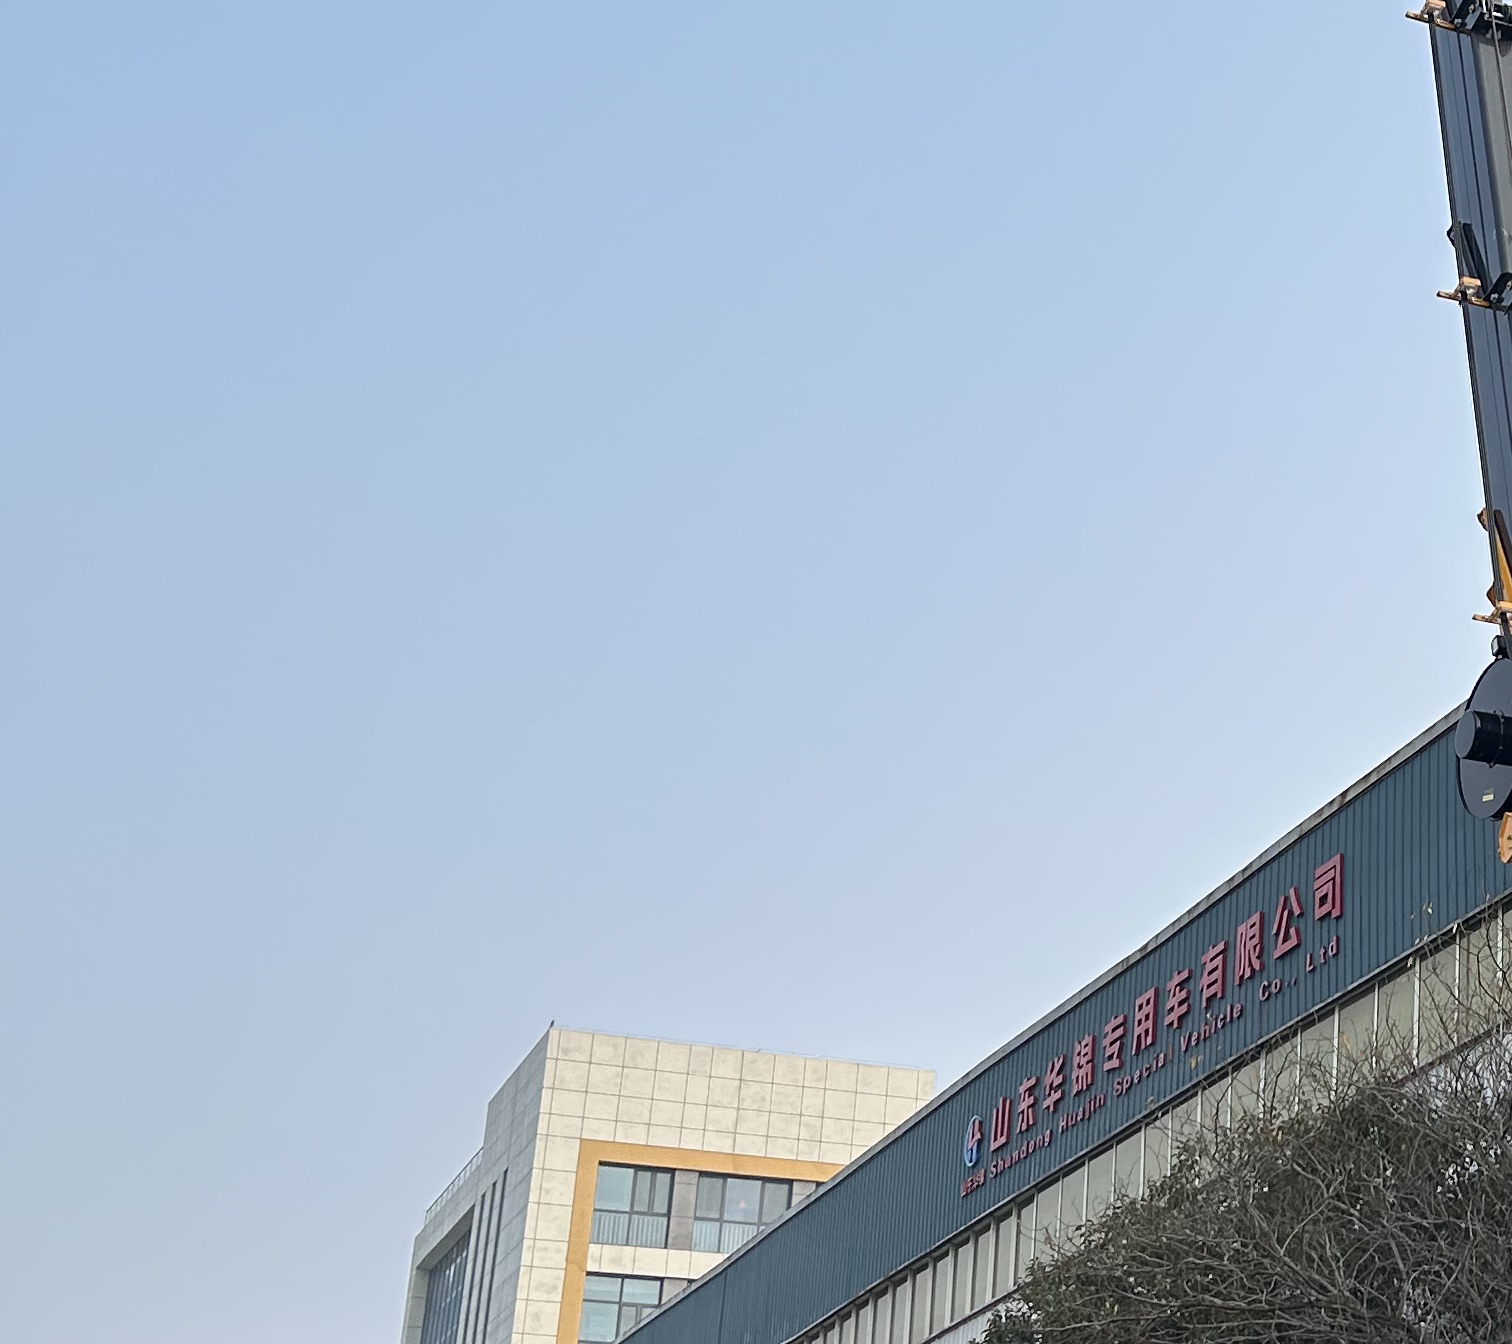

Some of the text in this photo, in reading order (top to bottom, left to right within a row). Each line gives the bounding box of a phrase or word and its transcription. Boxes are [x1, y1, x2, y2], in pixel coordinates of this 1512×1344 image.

[989, 1129, 1053, 1179] Shandong
[1059, 1093, 1105, 1134] Huajin
[1113, 1047, 1173, 1097] Special
[1180, 1002, 1243, 1053] Vehicle
[990, 853, 1343, 1152] 山东华锦专用车有限公司
